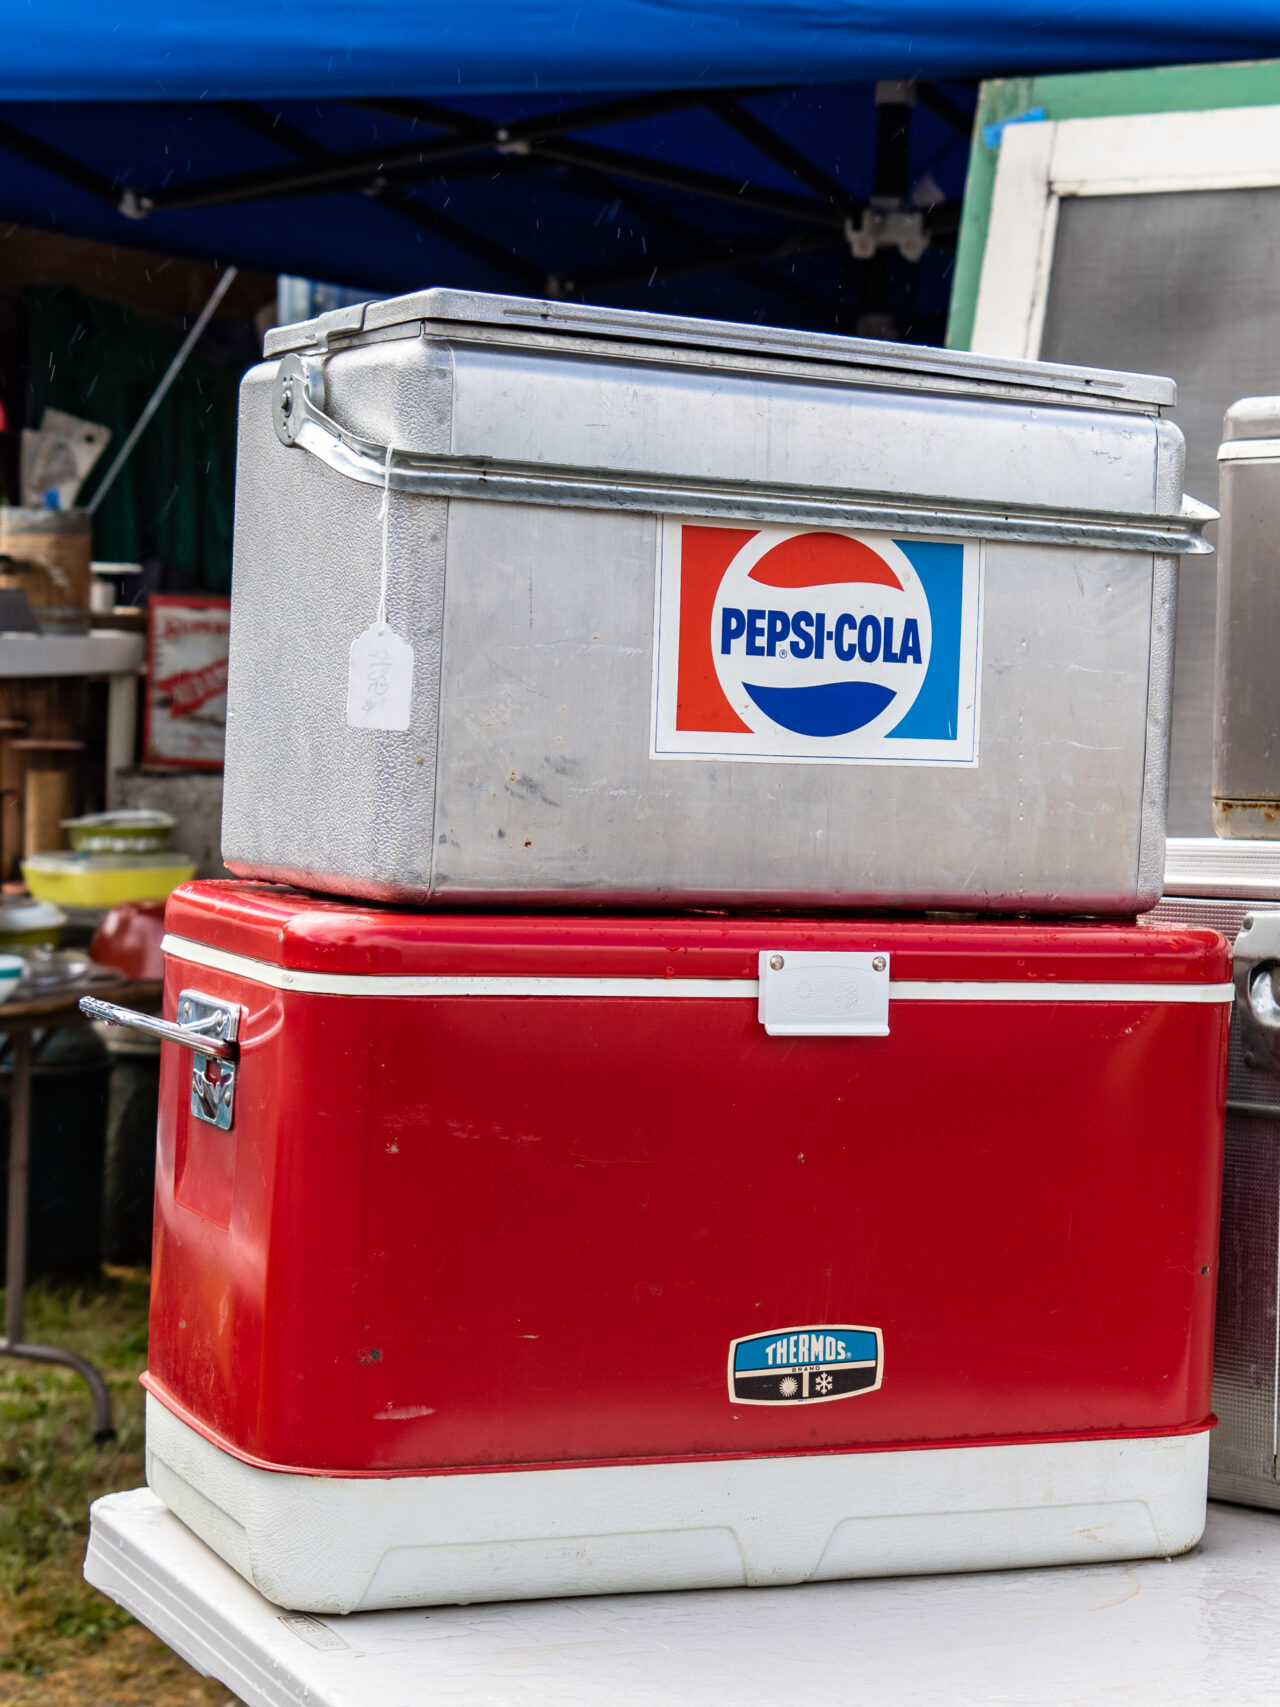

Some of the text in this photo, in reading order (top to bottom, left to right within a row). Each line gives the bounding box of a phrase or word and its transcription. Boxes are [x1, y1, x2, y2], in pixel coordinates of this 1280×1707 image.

[720, 607, 923, 665] PEPSI-COLA
[765, 1333, 847, 1366] THERMOS
[792, 1365, 821, 1373] BRAND
